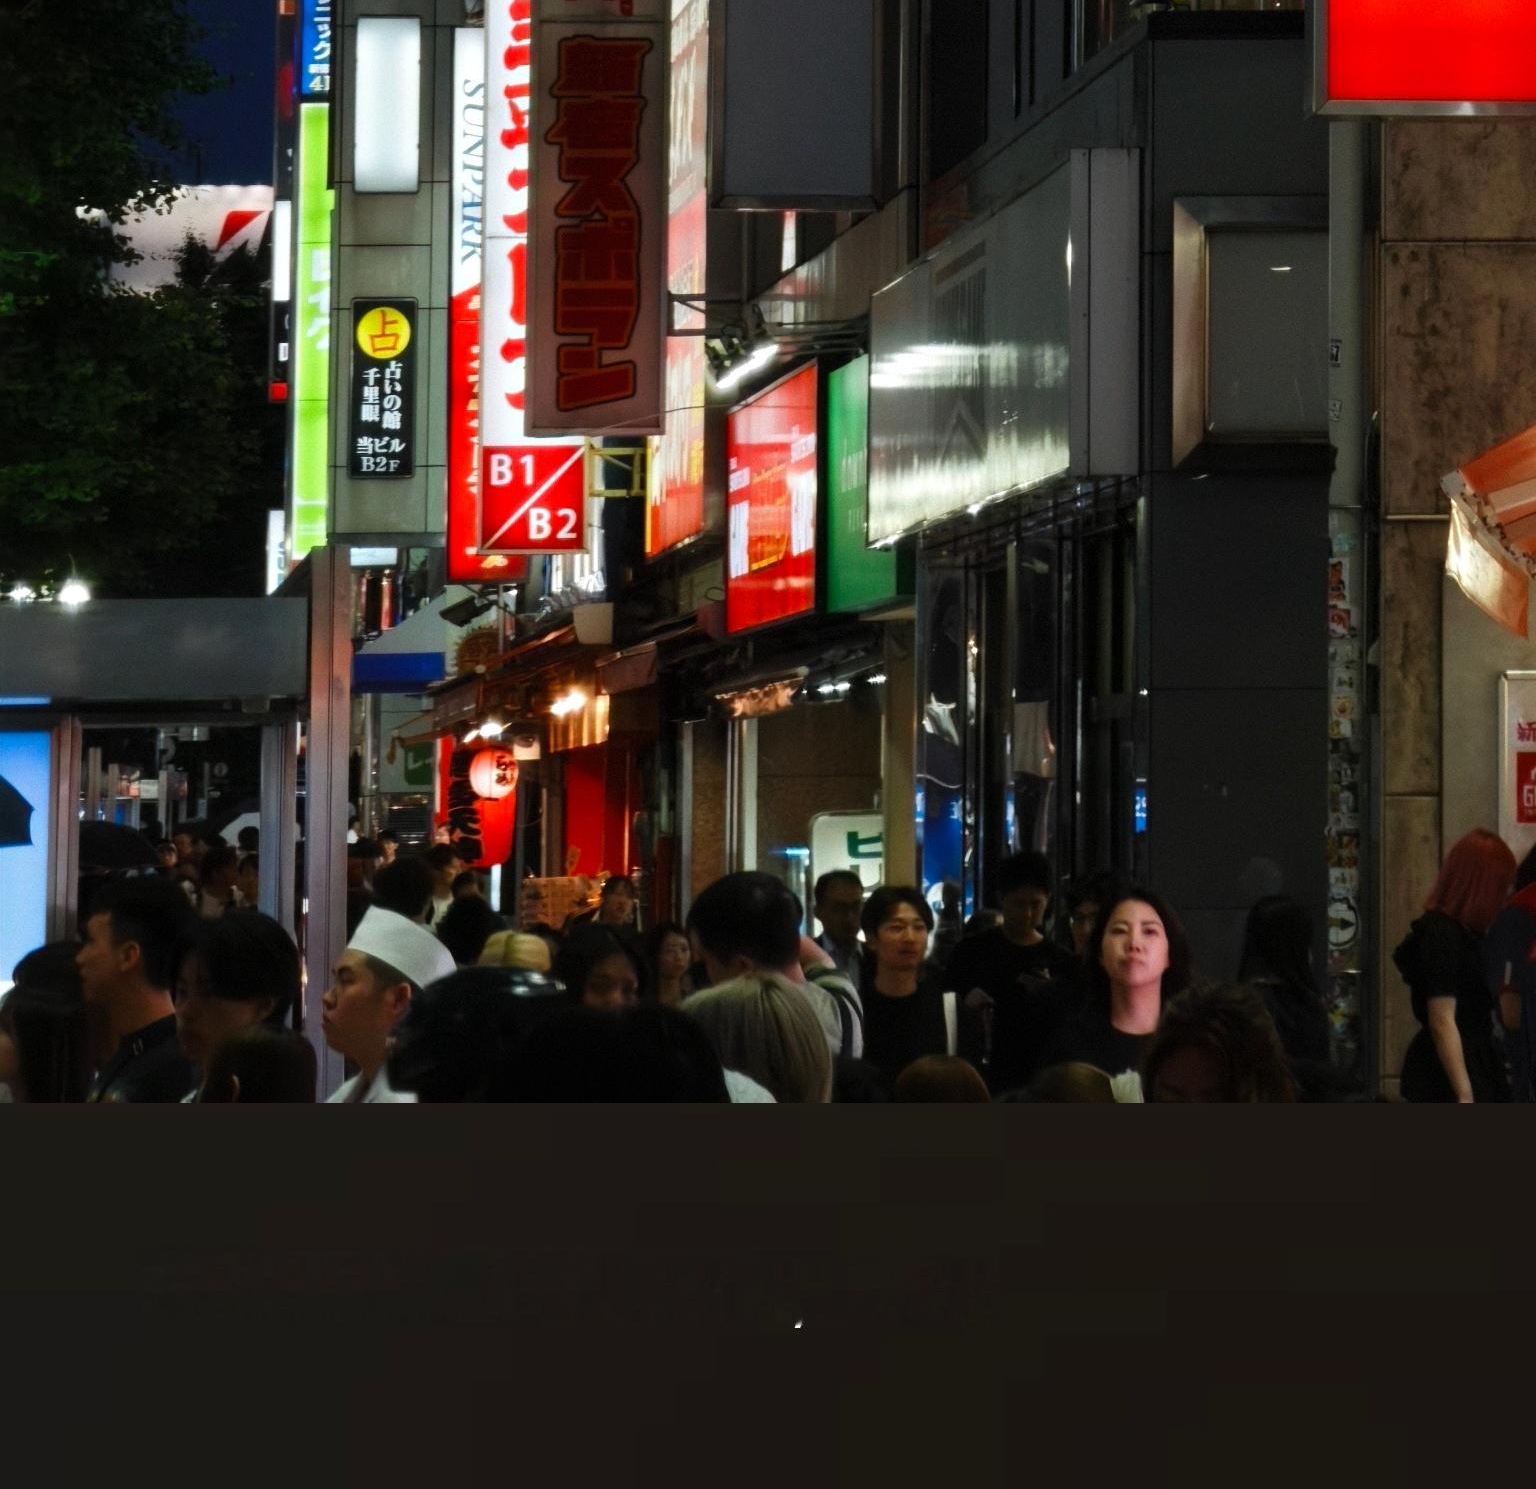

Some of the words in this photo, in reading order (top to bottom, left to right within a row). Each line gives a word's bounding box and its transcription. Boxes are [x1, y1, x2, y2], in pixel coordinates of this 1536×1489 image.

[461, 79, 485, 265] SUNPARK
[368, 309, 400, 353] 占
[361, 367, 382, 423] 千里眼
[382, 360, 403, 430] 占いの館
[356, 435, 406, 455] 当ビル
[360, 456, 401, 472] B2F
[489, 453, 536, 487] B1
[528, 507, 578, 541] B2
